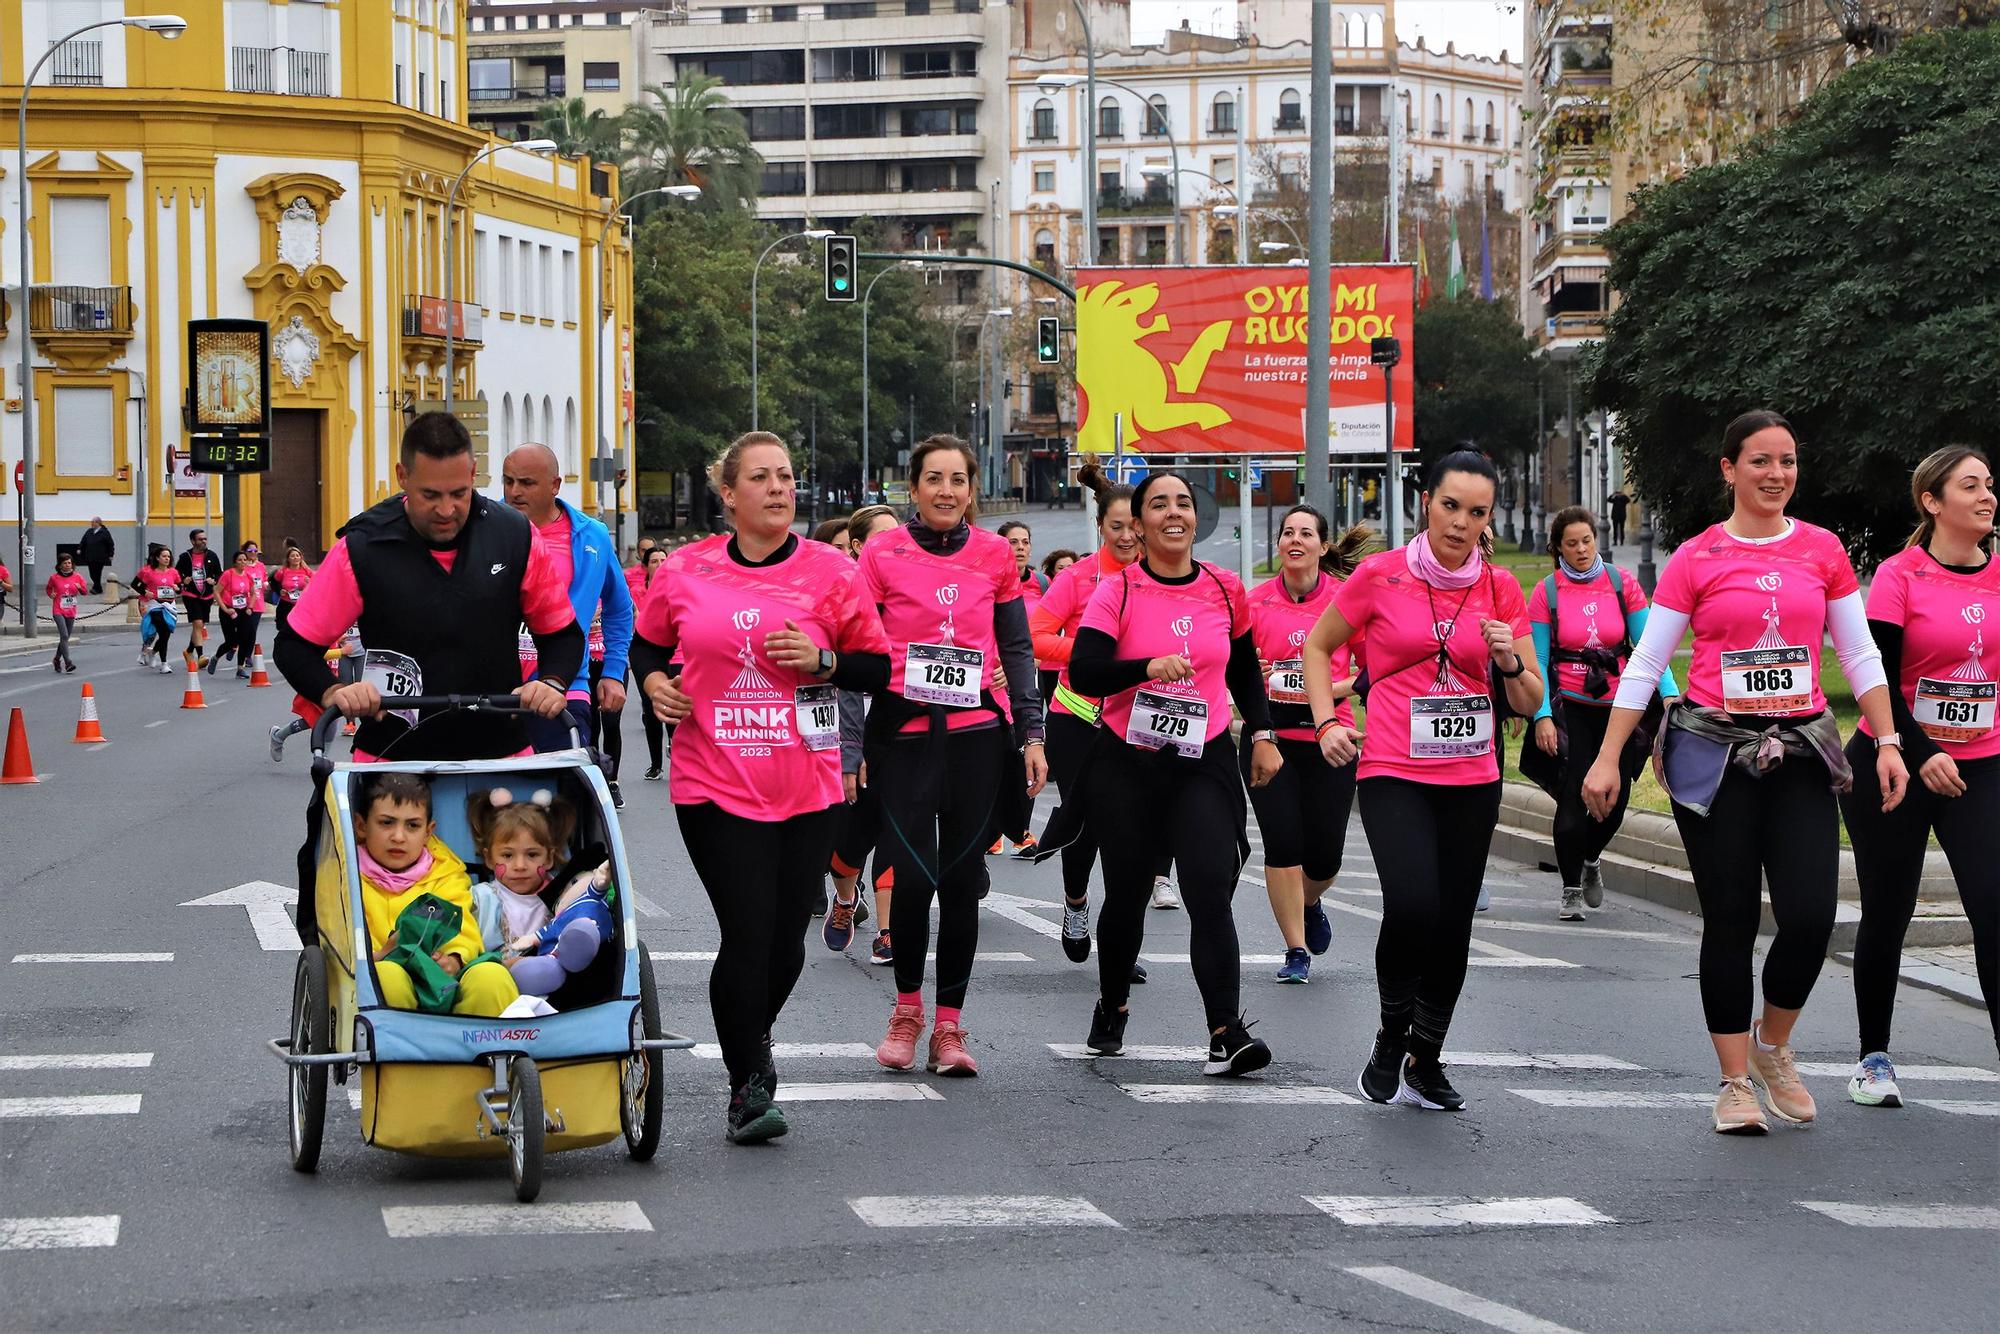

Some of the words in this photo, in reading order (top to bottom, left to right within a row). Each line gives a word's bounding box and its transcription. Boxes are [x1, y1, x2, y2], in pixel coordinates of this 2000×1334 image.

[1335, 283, 1377, 313] MI
[1245, 354, 1260, 366] La
[1264, 354, 1307, 366] fuerza
[1245, 371, 1298, 382] nuestra
[1300, 369, 1368, 383] pvincia
[1341, 422, 1381, 430] Diputación
[208, 446, 258, 461] 10:32
[924, 664, 966, 687] 1263
[1742, 668, 1793, 692] 1863
[724, 691, 738, 699] VIII
[740, 690, 782, 699] EDICIÓN
[1166, 685, 1200, 696] EDICIÓN
[714, 707, 791, 727] PINK
[811, 705, 835, 728] 1430
[1936, 701, 1979, 722] 1631
[1150, 713, 1189, 737] 1279
[1431, 716, 1476, 737] 1329
[714, 729, 790, 740] RUNNING
[740, 747, 772, 757] 2023
[462, 1028, 541, 1043] INFANTASTIC
